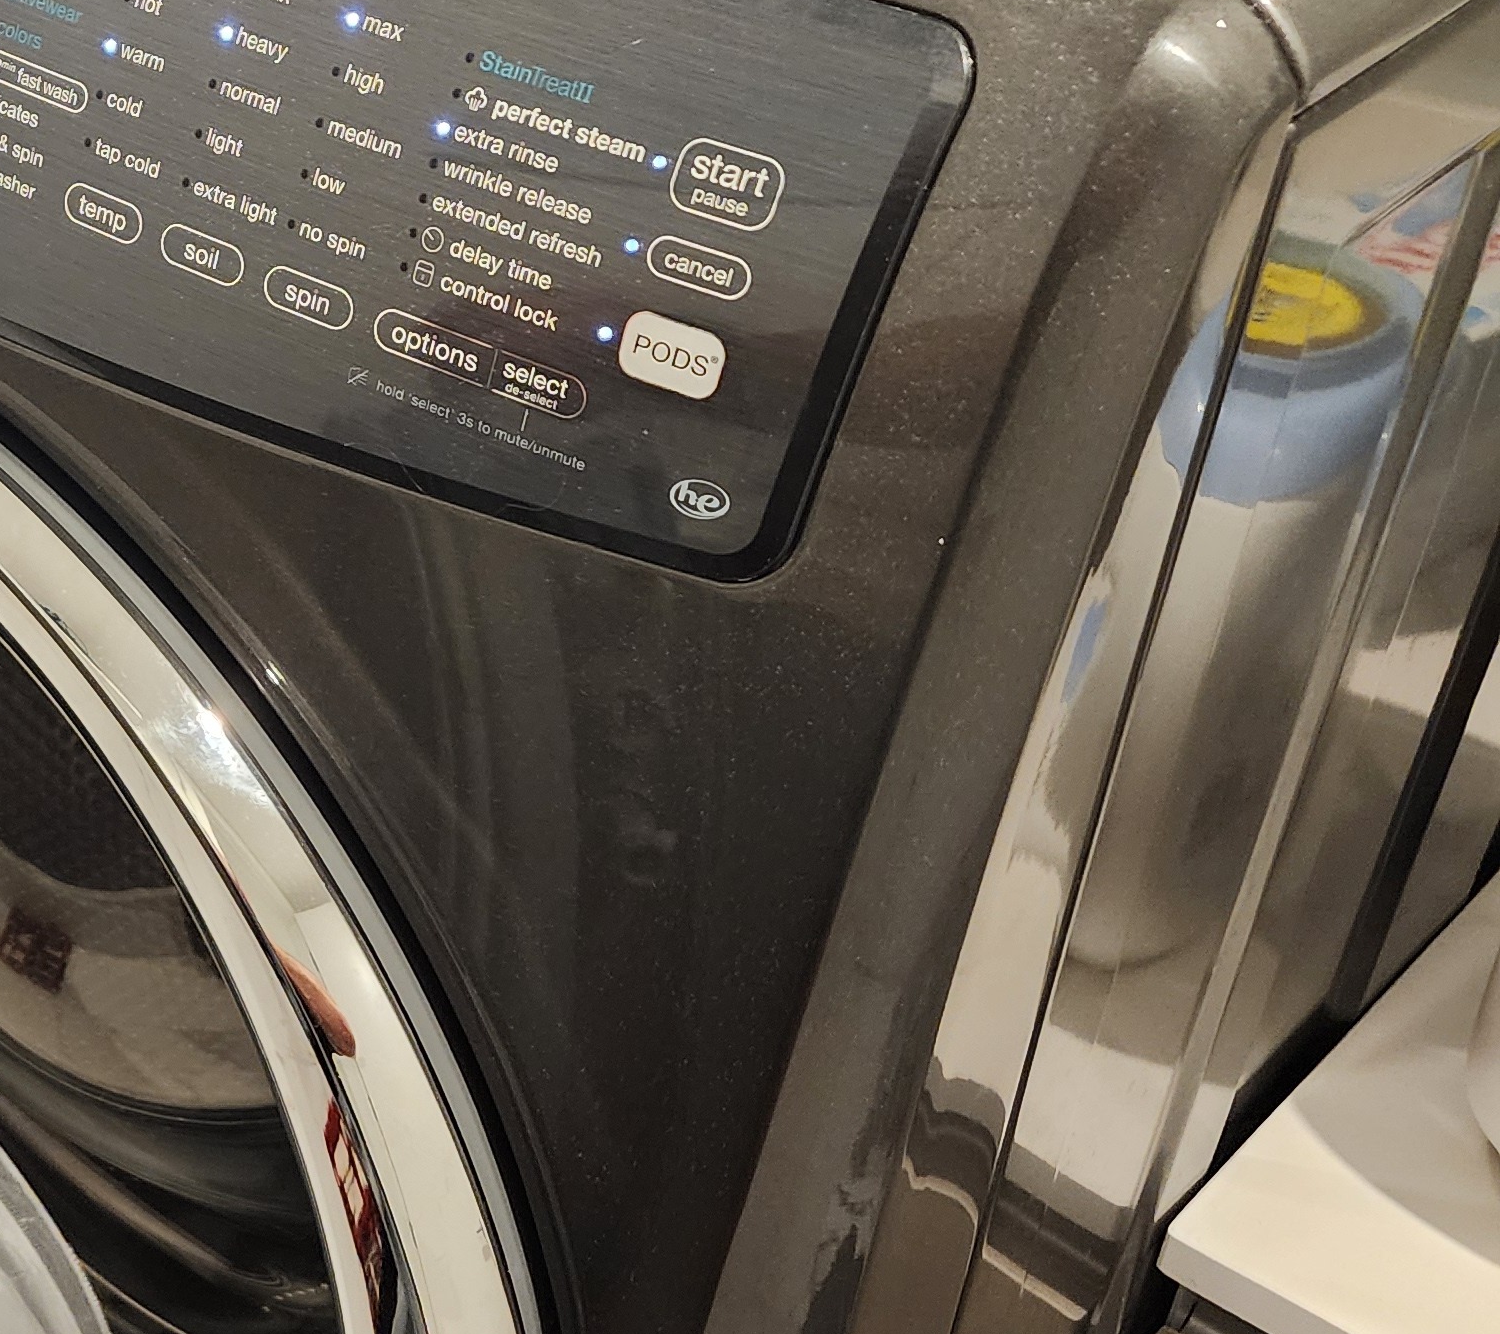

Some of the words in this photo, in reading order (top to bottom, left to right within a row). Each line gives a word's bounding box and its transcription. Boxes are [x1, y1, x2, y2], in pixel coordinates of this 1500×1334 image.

[235, 26, 289, 64] heavy
[361, 13, 405, 42] max
[120, 42, 165, 73] warm
[16, 68, 42, 92] fast
[42, 81, 78, 106] wash
[219, 80, 282, 116] normal
[343, 63, 385, 95] high
[106, 91, 144, 118] cold
[205, 127, 244, 157] light
[327, 119, 402, 159] medium
[454, 123, 504, 156] extra
[508, 140, 559, 174] rinse
[491, 98, 573, 139] perfect
[574, 124, 646, 163] steam
[11, 143, 44, 168] spin
[95, 137, 122, 165] tap
[124, 153, 161, 179] cold
[312, 167, 346, 195] low
[443, 158, 513, 197] wrinkle
[517, 181, 592, 225] release
[690, 153, 770, 198] start
[78, 194, 127, 234] temp
[193, 181, 236, 210] extra
[239, 195, 278, 226] light
[690, 187, 749, 217] pause
[299, 220, 322, 242] no
[327, 232, 366, 260] spin
[432, 194, 526, 240] extended
[529, 228, 602, 268] refresh
[183, 243, 220, 270] soil
[449, 240, 503, 276] delay
[507, 259, 552, 290] time
[664, 251, 734, 287] cancel
[284, 283, 330, 316] spin
[440, 274, 510, 315] control
[514, 298, 559, 332] lock
[391, 323, 479, 373] options
[502, 359, 568, 401] select
[504, 382, 558, 411] de-select
[376, 379, 405, 401] hold
[457, 412, 474, 428] 3s
[477, 420, 491, 435] to
[494, 427, 586, 471] mute/unmute
